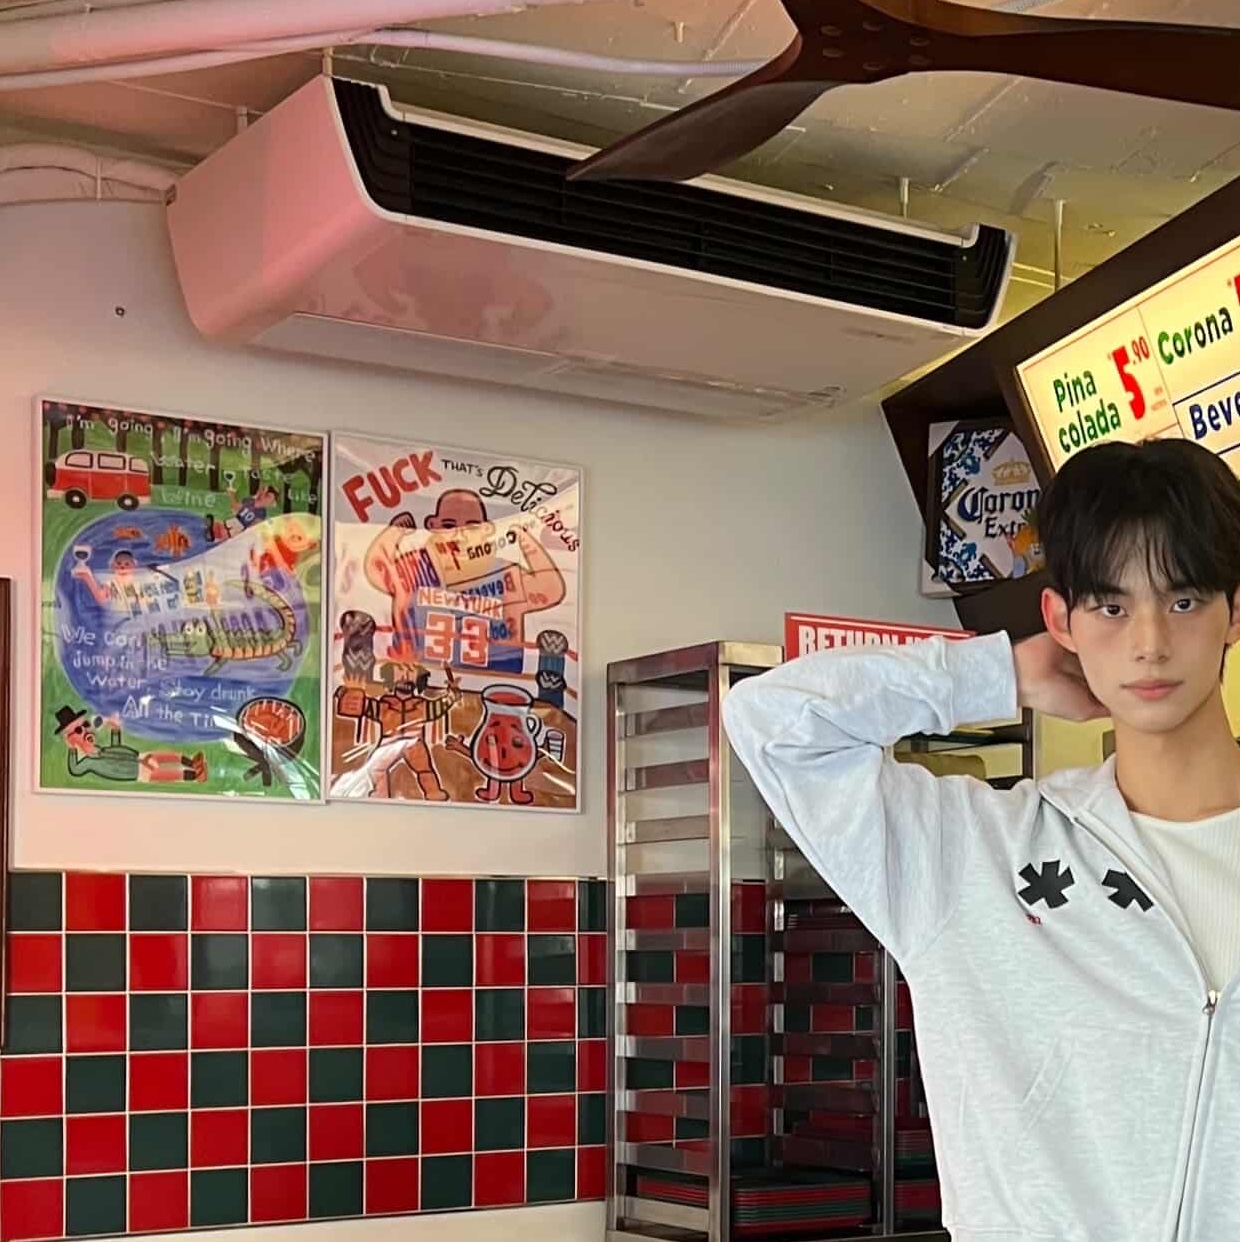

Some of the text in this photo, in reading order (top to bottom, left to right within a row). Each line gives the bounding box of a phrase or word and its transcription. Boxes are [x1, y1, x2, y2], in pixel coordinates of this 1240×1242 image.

[1157, 306, 1234, 365] Corona
[1053, 369, 1098, 413] Pina
[1058, 399, 1122, 453] colada
[341, 450, 443, 524] FUCK
[957, 486, 1041, 525] Coron
